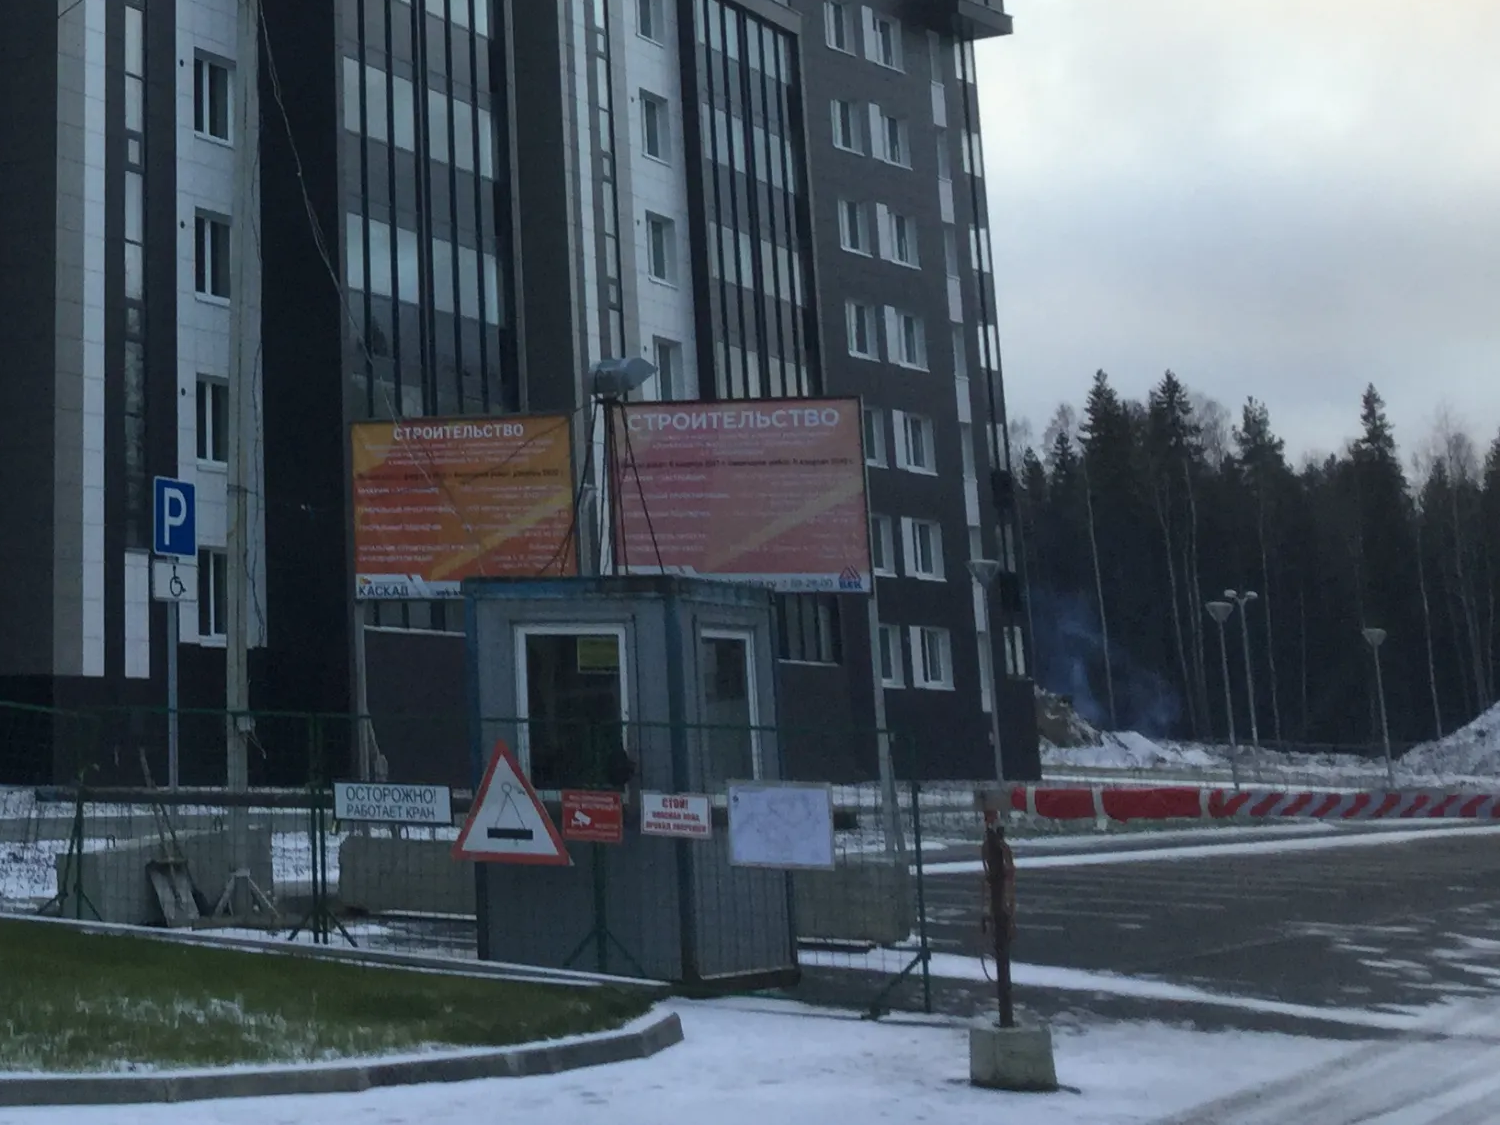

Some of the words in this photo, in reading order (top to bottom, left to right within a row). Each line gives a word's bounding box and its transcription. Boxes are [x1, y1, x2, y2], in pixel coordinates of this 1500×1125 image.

[627, 408, 840, 431] СТРОИТЕЛЬСТВО
[393, 423, 524, 441] СТРОИТЕЛЬСТВО
[163, 487, 187, 546] P
[358, 585, 409, 597] КАСКАД
[346, 786, 437, 804] ОСТОРОЖНО!
[662, 796, 689, 810] СТОЙ!
[347, 803, 402, 817] РАБОТАЕТ
[405, 806, 435, 819] КРАН
